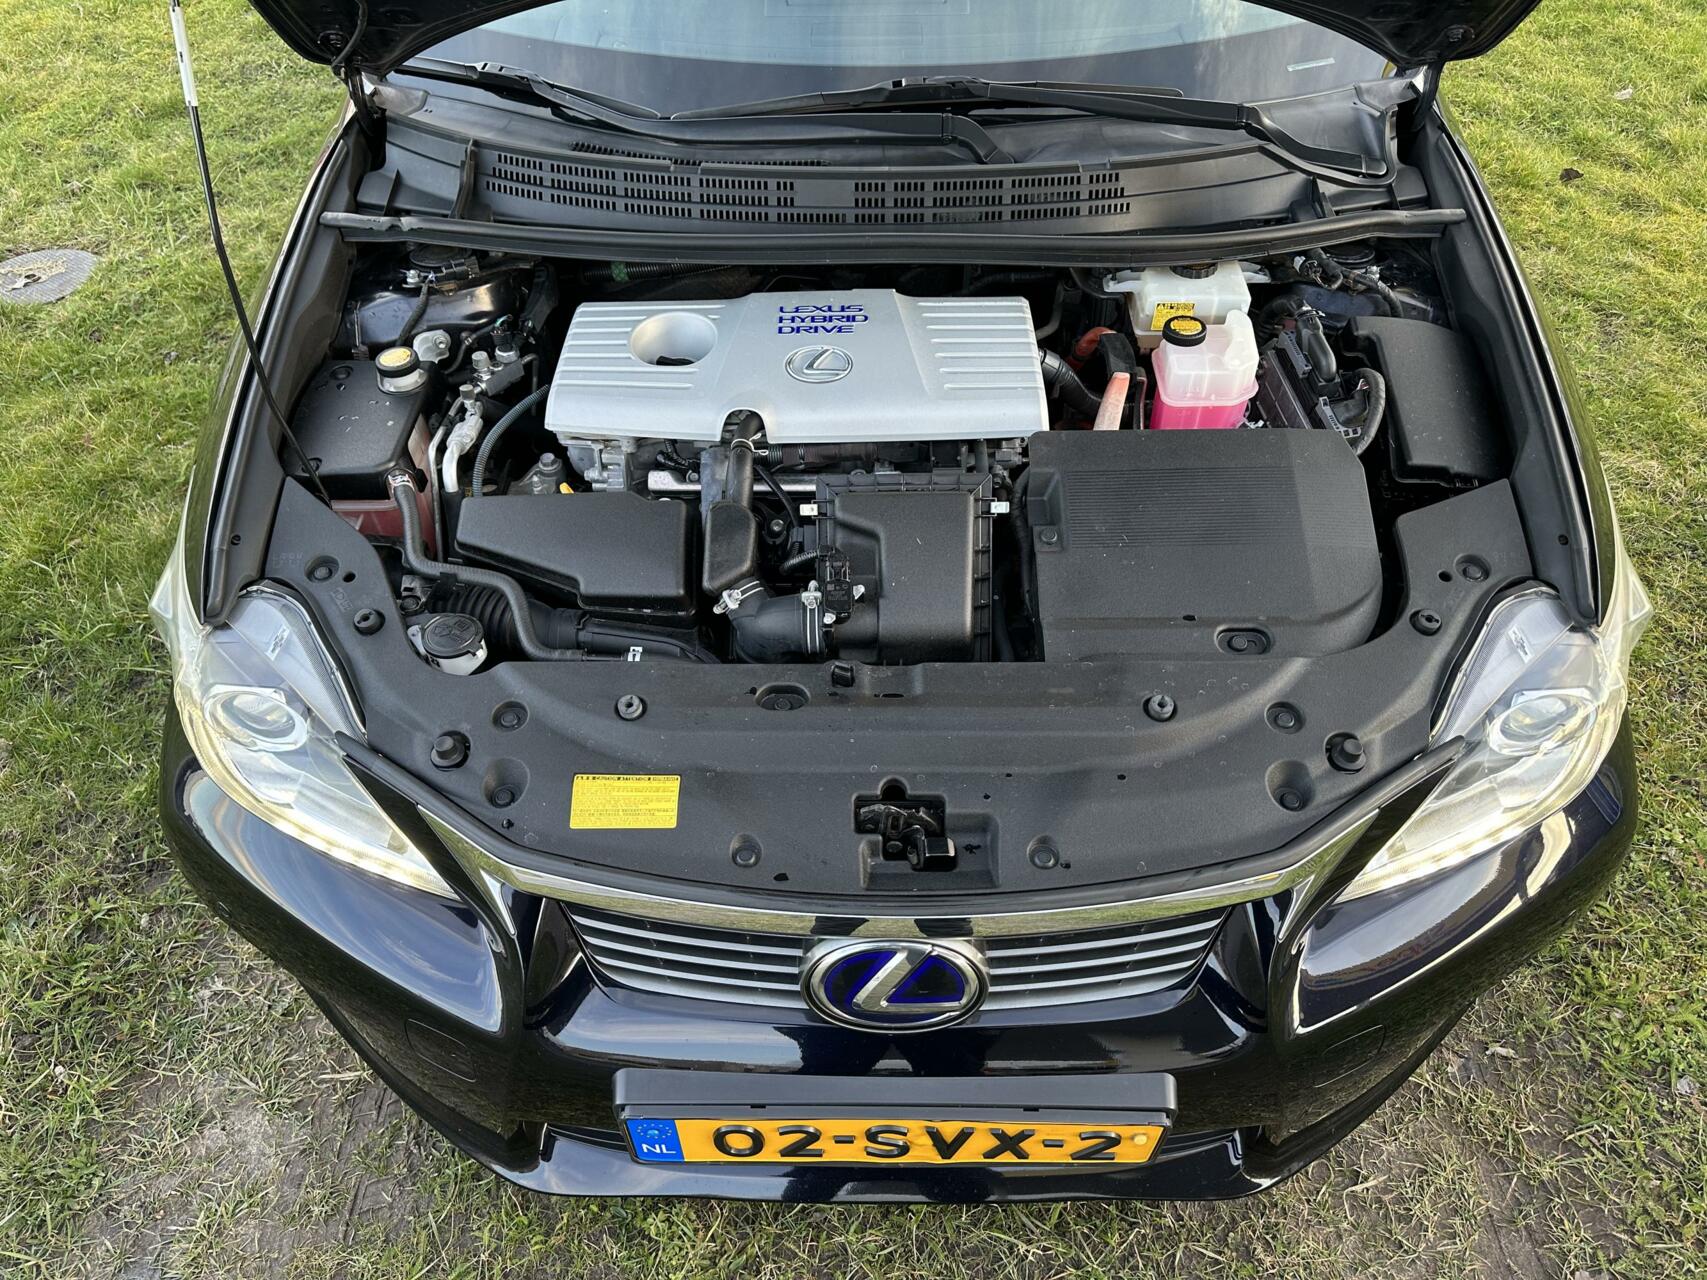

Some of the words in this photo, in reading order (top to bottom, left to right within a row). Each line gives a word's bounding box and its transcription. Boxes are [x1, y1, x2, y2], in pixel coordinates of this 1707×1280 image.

[779, 305, 863, 313] LEXUS
[778, 314, 869, 323] HYBRID
[777, 325, 854, 334] DRIVE
[641, 1143, 676, 1153] NL
[712, 1124, 1122, 1160] 02-SVX-2
